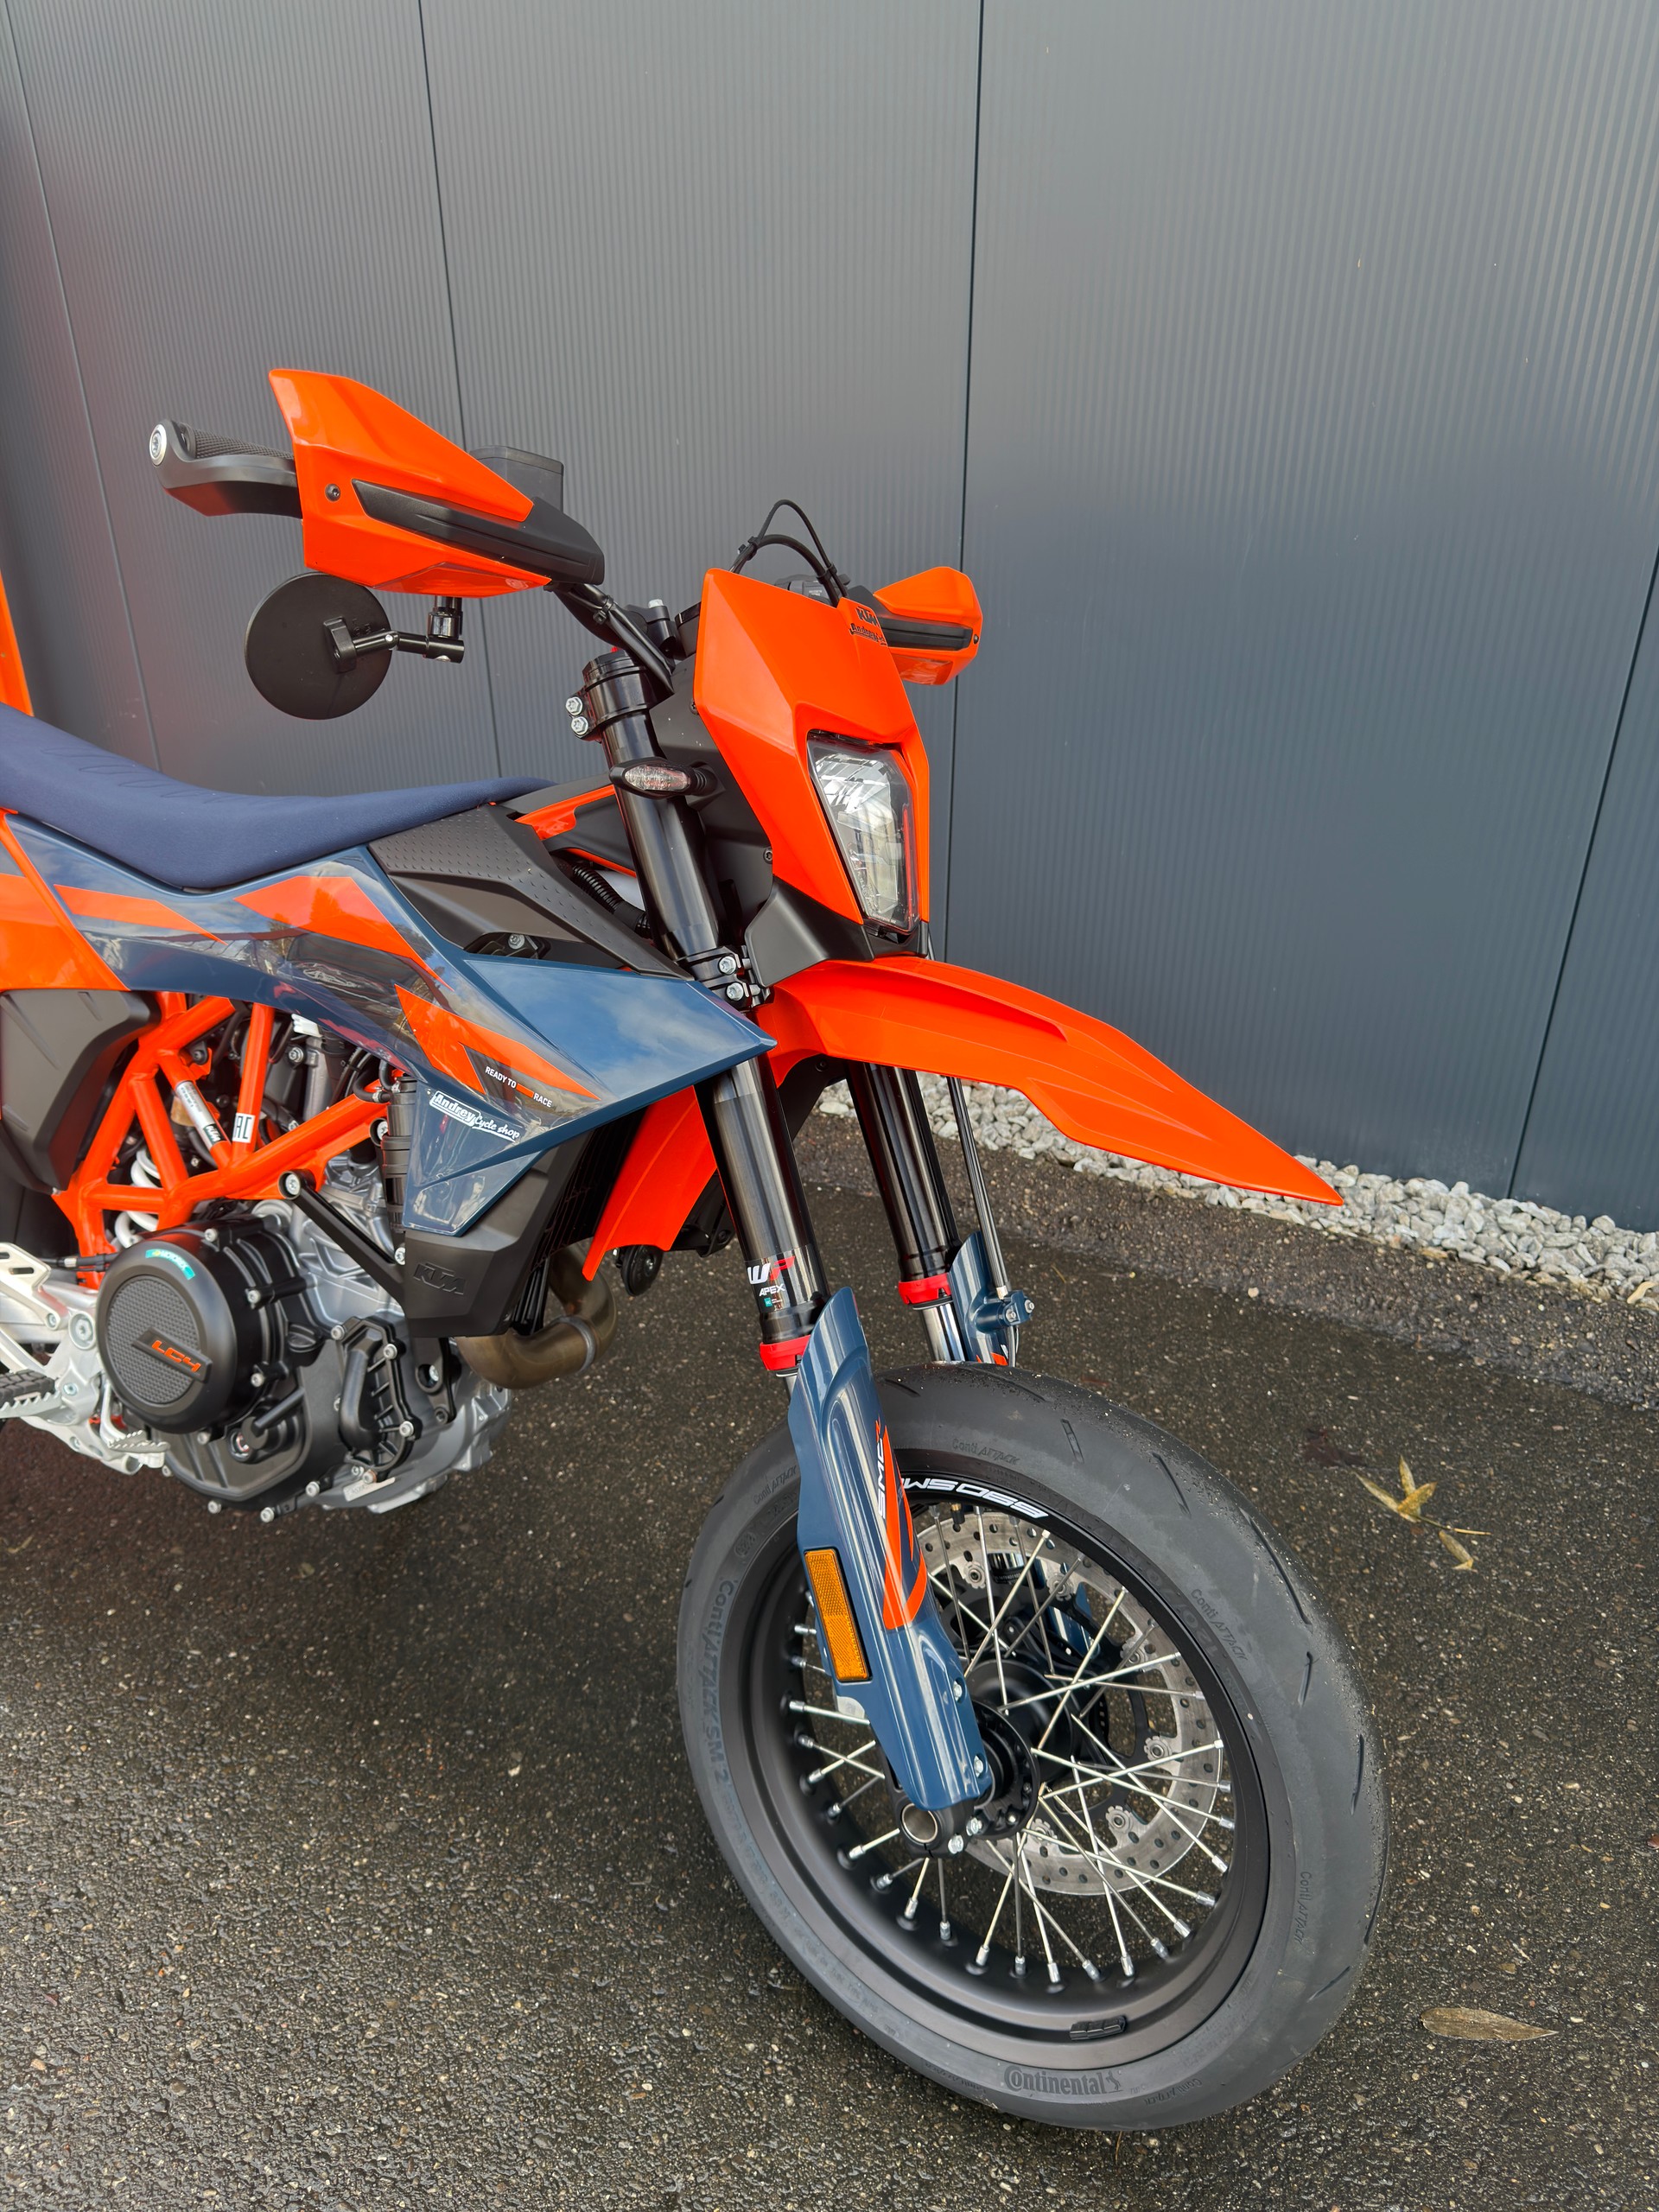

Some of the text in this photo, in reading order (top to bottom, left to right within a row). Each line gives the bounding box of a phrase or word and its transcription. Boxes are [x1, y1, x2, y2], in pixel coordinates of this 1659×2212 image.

[485, 1066, 553, 1108] READY TO RACE
[434, 1094, 520, 1140] Andrey Cycle shop
[413, 1262, 466, 1295] KTM
[760, 1282, 786, 1297] APEX
[151, 1340, 201, 1373] LC4
[1004, 2064, 1107, 2095] Continental
